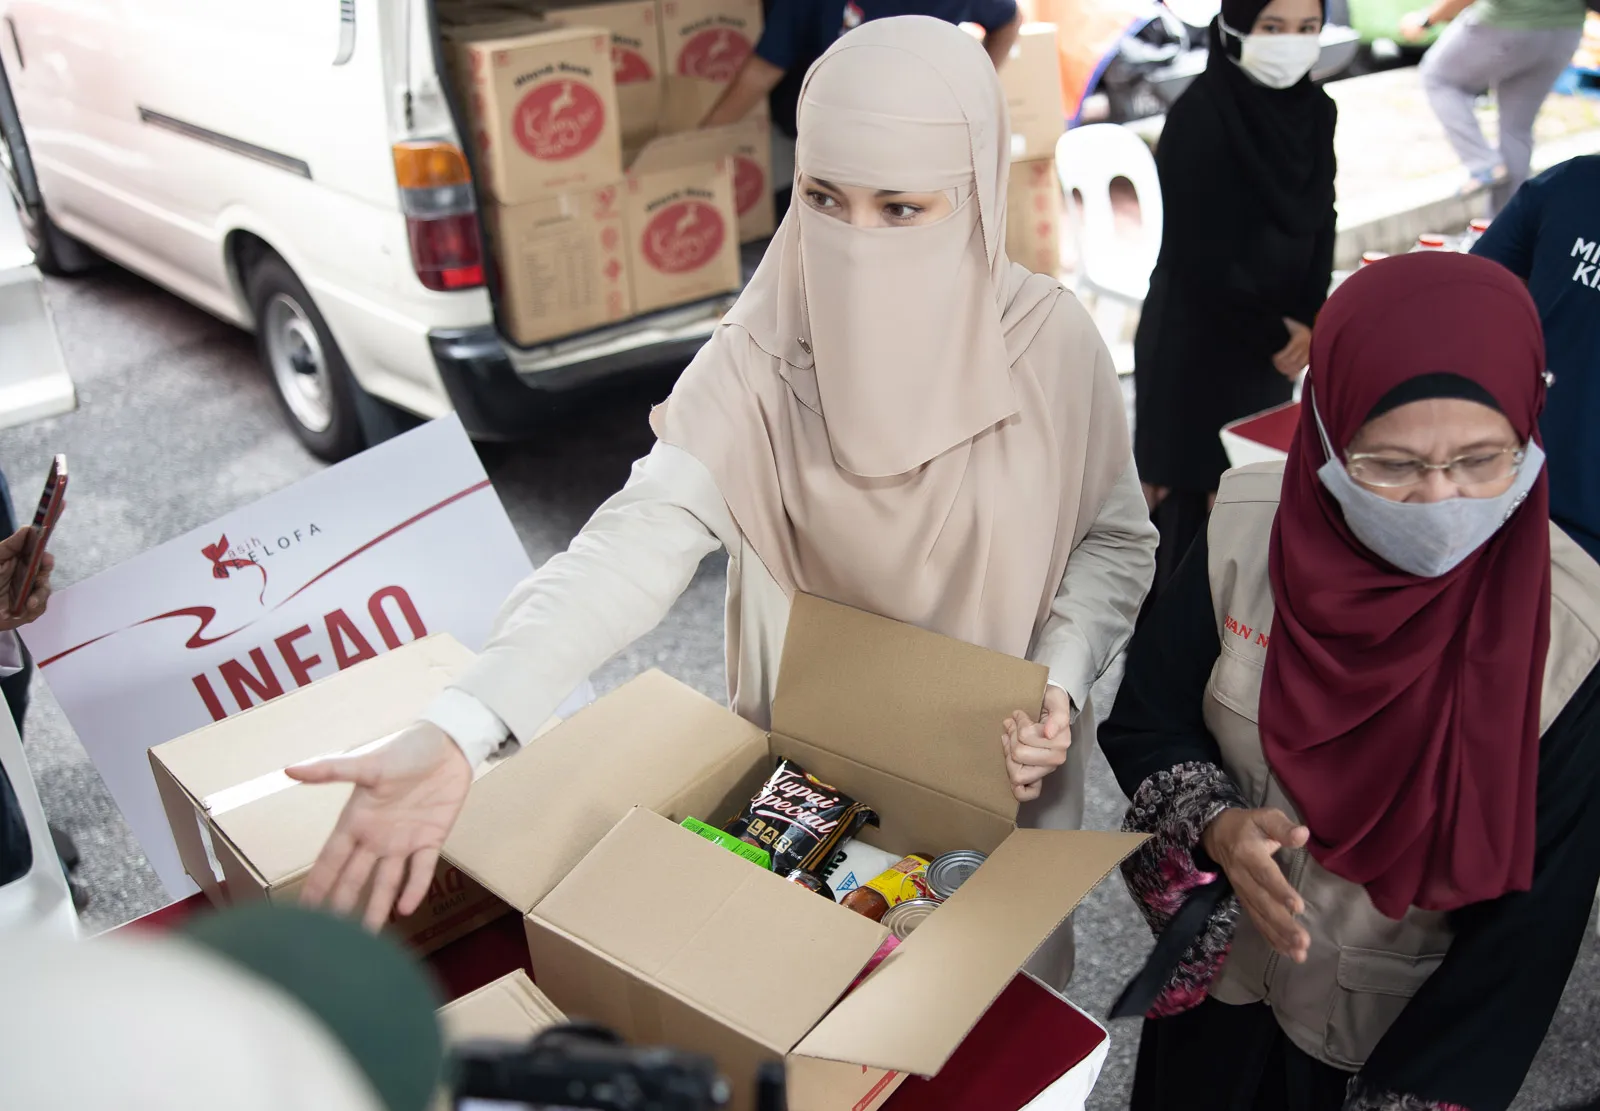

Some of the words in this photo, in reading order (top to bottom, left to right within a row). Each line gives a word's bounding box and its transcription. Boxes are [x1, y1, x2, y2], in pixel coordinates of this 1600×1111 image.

[215, 523, 321, 579] NEELOFA
[750, 785, 839, 834] Special
[764, 769, 840, 808] Tupai
